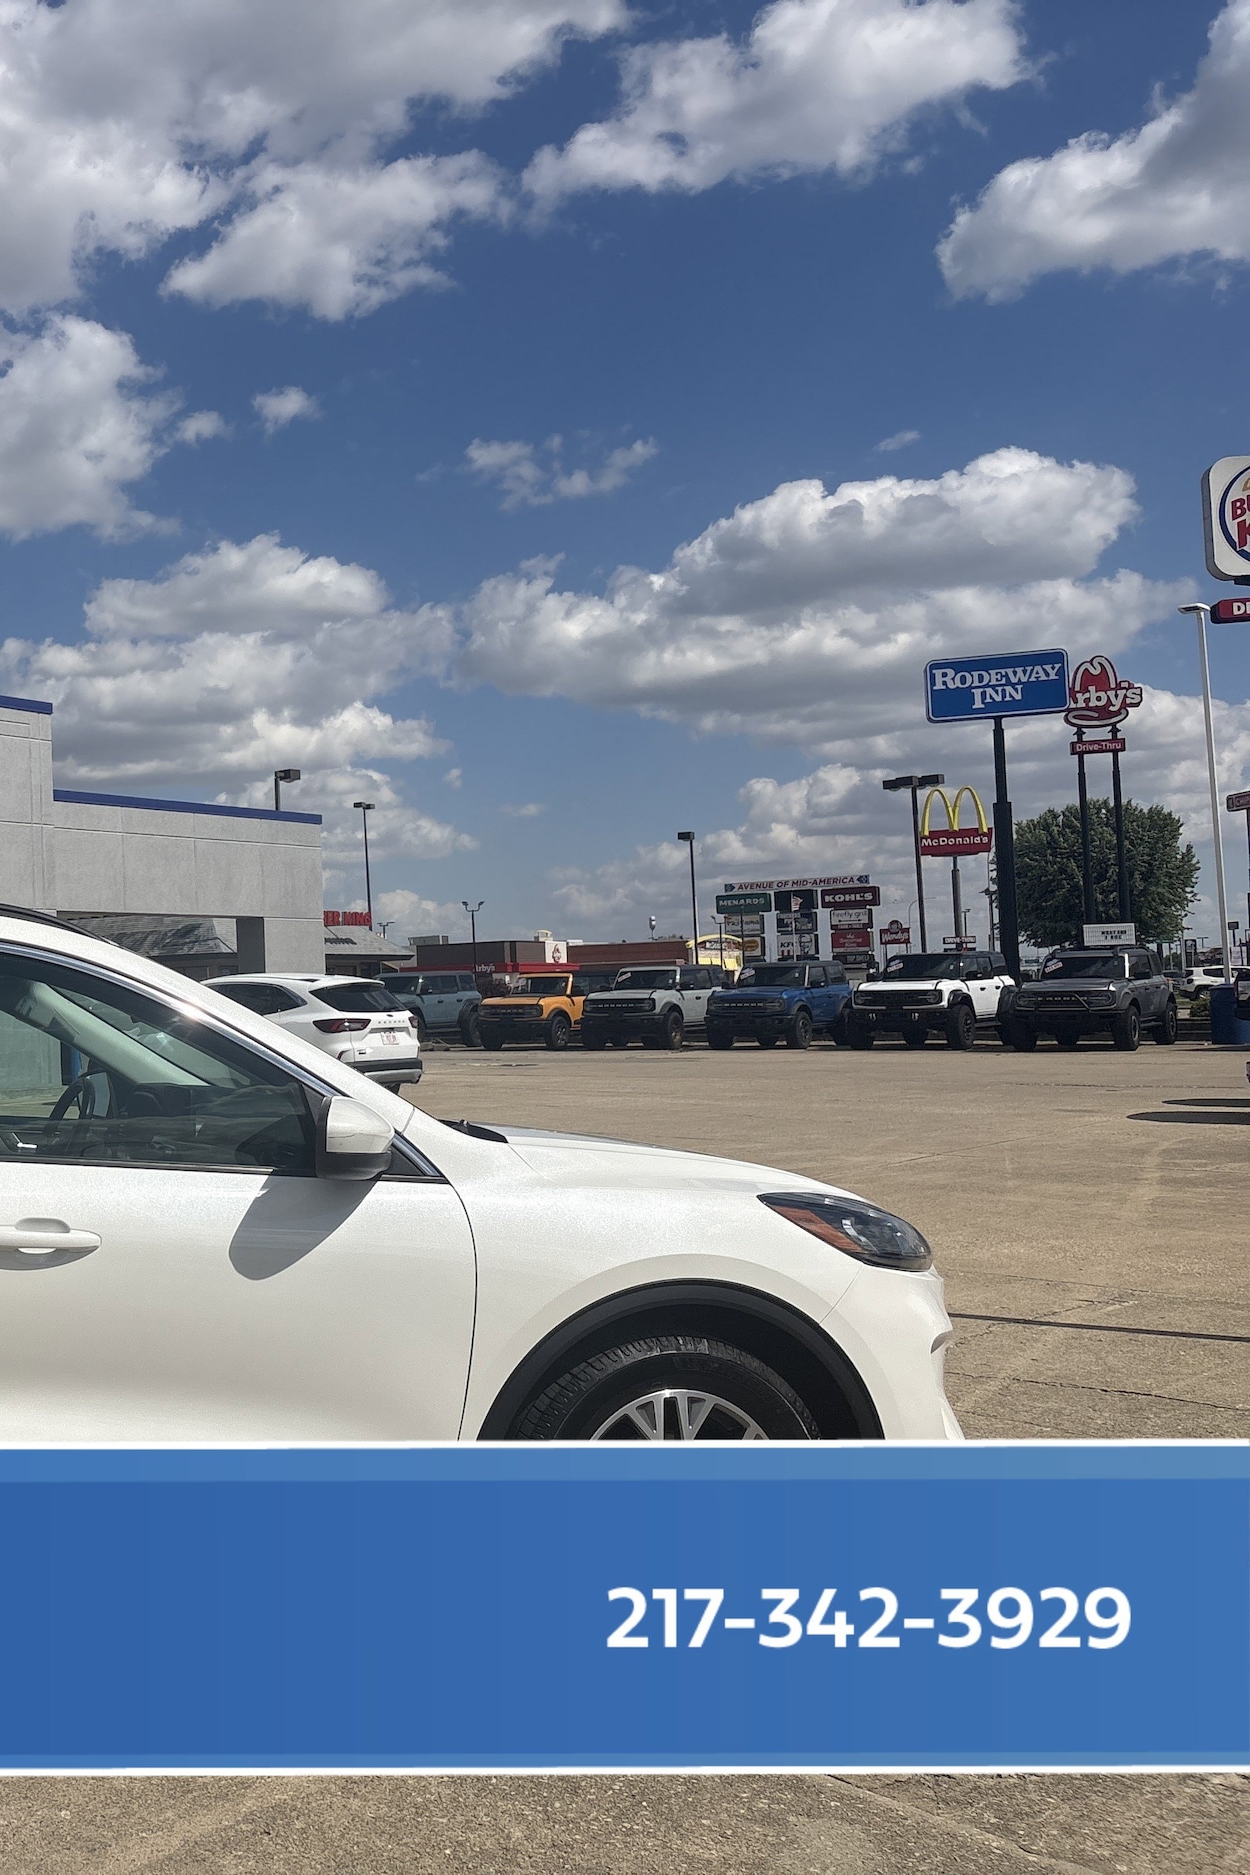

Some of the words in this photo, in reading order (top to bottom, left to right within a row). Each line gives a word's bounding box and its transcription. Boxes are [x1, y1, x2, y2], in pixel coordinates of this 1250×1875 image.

[931, 662, 1063, 691] RODEWAY
[971, 684, 1024, 709] INN
[1076, 741, 1122, 753] Drive-Thru
[921, 835, 989, 847] McDonald's
[737, 881, 774, 891] AVENUE
[776, 880, 790, 888] OF
[791, 876, 855, 887] MID-AMERICA
[719, 897, 765, 907] MENARDS
[824, 892, 873, 902] KOHL'S
